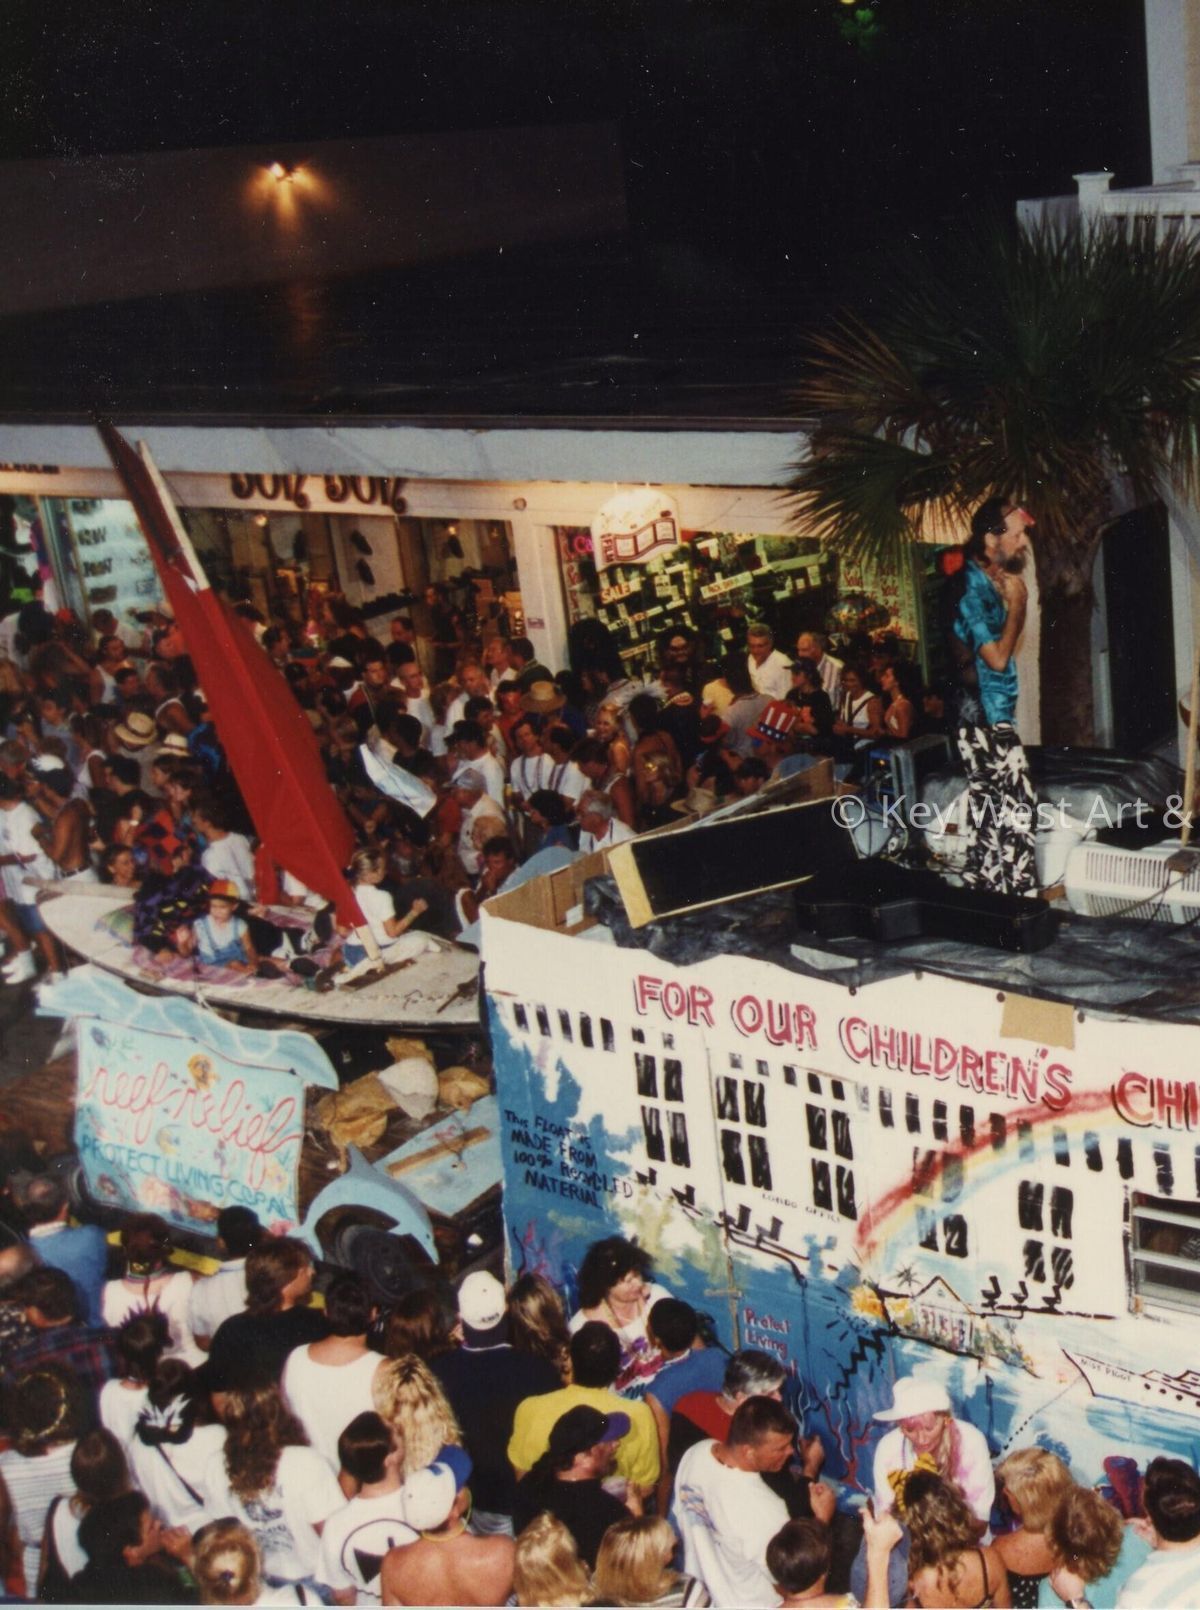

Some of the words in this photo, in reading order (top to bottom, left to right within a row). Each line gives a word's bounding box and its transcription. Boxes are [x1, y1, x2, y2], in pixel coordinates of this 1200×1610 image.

[634, 974, 715, 1028] FOR
[731, 995, 818, 1051] OUR
[839, 1016, 1076, 1113] CHILDREN'S
[84, 1062, 180, 1145] reef
[174, 1079, 303, 1191] relief
[535, 1115, 572, 1138] FLOAT
[81, 1134, 161, 1177] PROTECT
[166, 1159, 225, 1199] LIVING
[512, 1130, 553, 1153] MADE
[560, 1141, 598, 1170] FROM
[743, 1306, 790, 1335] Protect
[744, 1328, 789, 1362] Living
